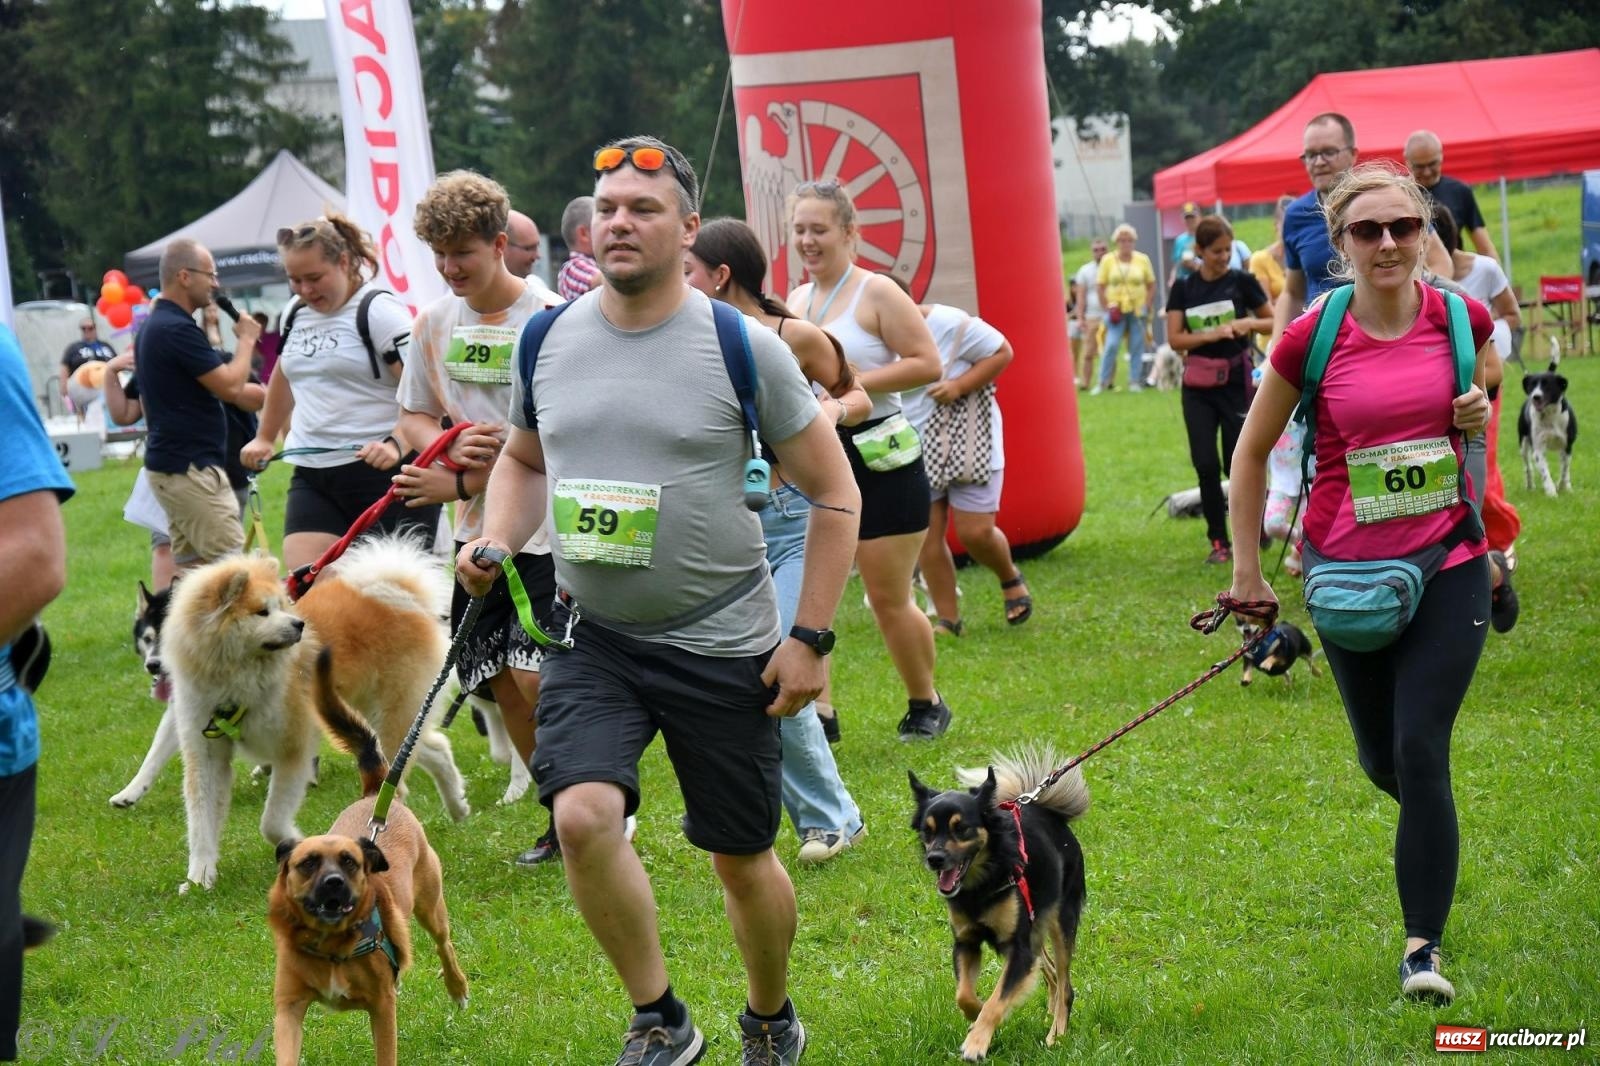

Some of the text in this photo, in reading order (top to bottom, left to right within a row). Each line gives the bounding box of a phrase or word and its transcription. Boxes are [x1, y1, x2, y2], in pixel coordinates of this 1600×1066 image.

[464, 344, 491, 363] 29
[888, 434, 900, 450] 4
[1347, 440, 1450, 461] ZOO-MAR DOGTREKKING
[1385, 465, 1427, 493] 60
[593, 484, 657, 498] DOGTREKKING
[577, 508, 619, 536] 59
